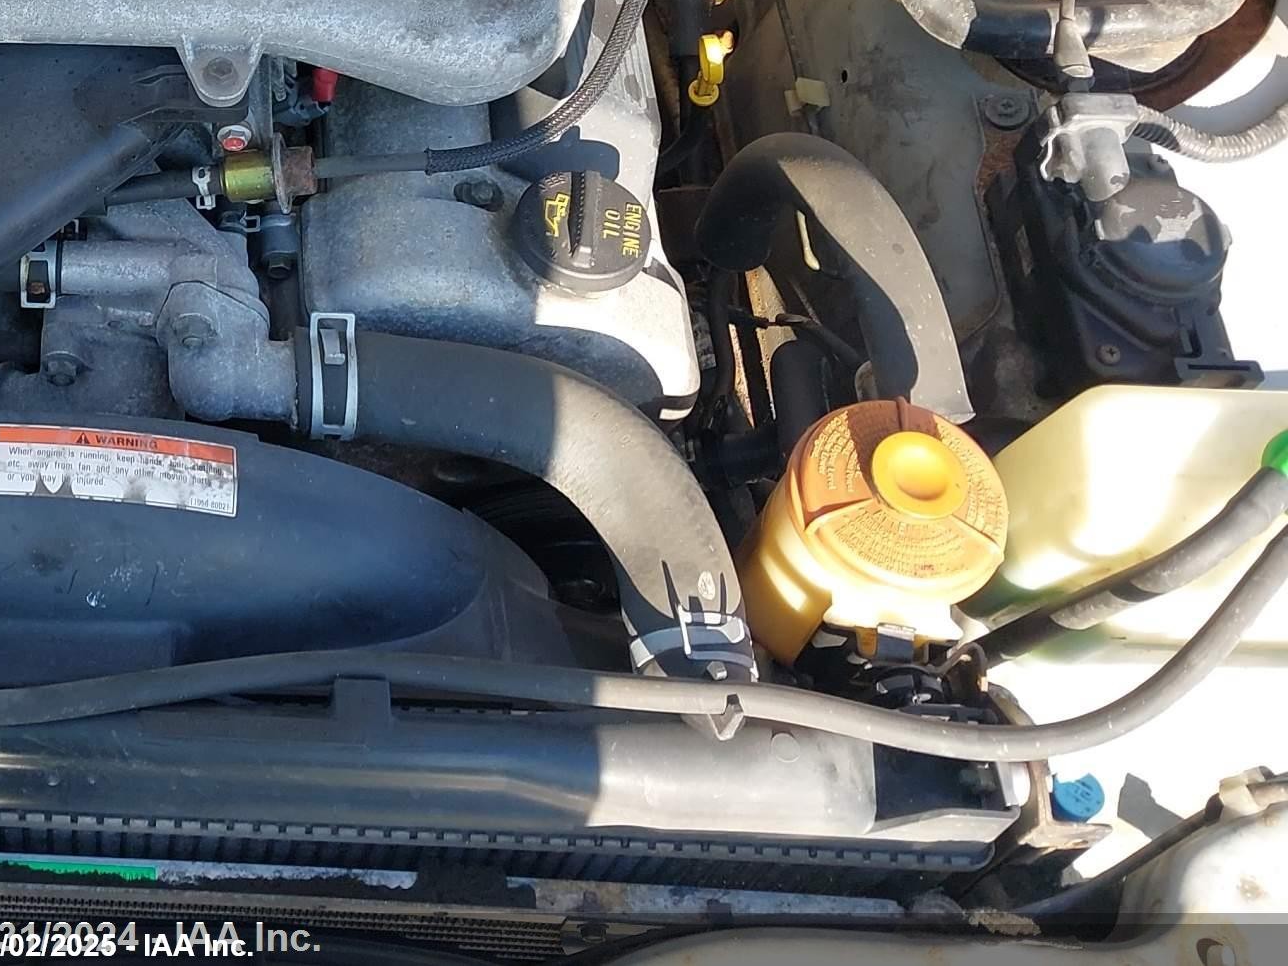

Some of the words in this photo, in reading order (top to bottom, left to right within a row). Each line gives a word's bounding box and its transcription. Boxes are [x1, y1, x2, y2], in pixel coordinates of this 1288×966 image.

[602, 208, 621, 239] OIL
[622, 202, 642, 258] ENGINE
[95, 434, 158, 451] WARNING
[68, 449, 75, 457] is
[116, 452, 135, 464] keep
[27, 461, 49, 471] away
[54, 461, 73, 470] from
[78, 462, 91, 471] fan
[115, 466, 129, 476] any
[133, 467, 154, 478] other
